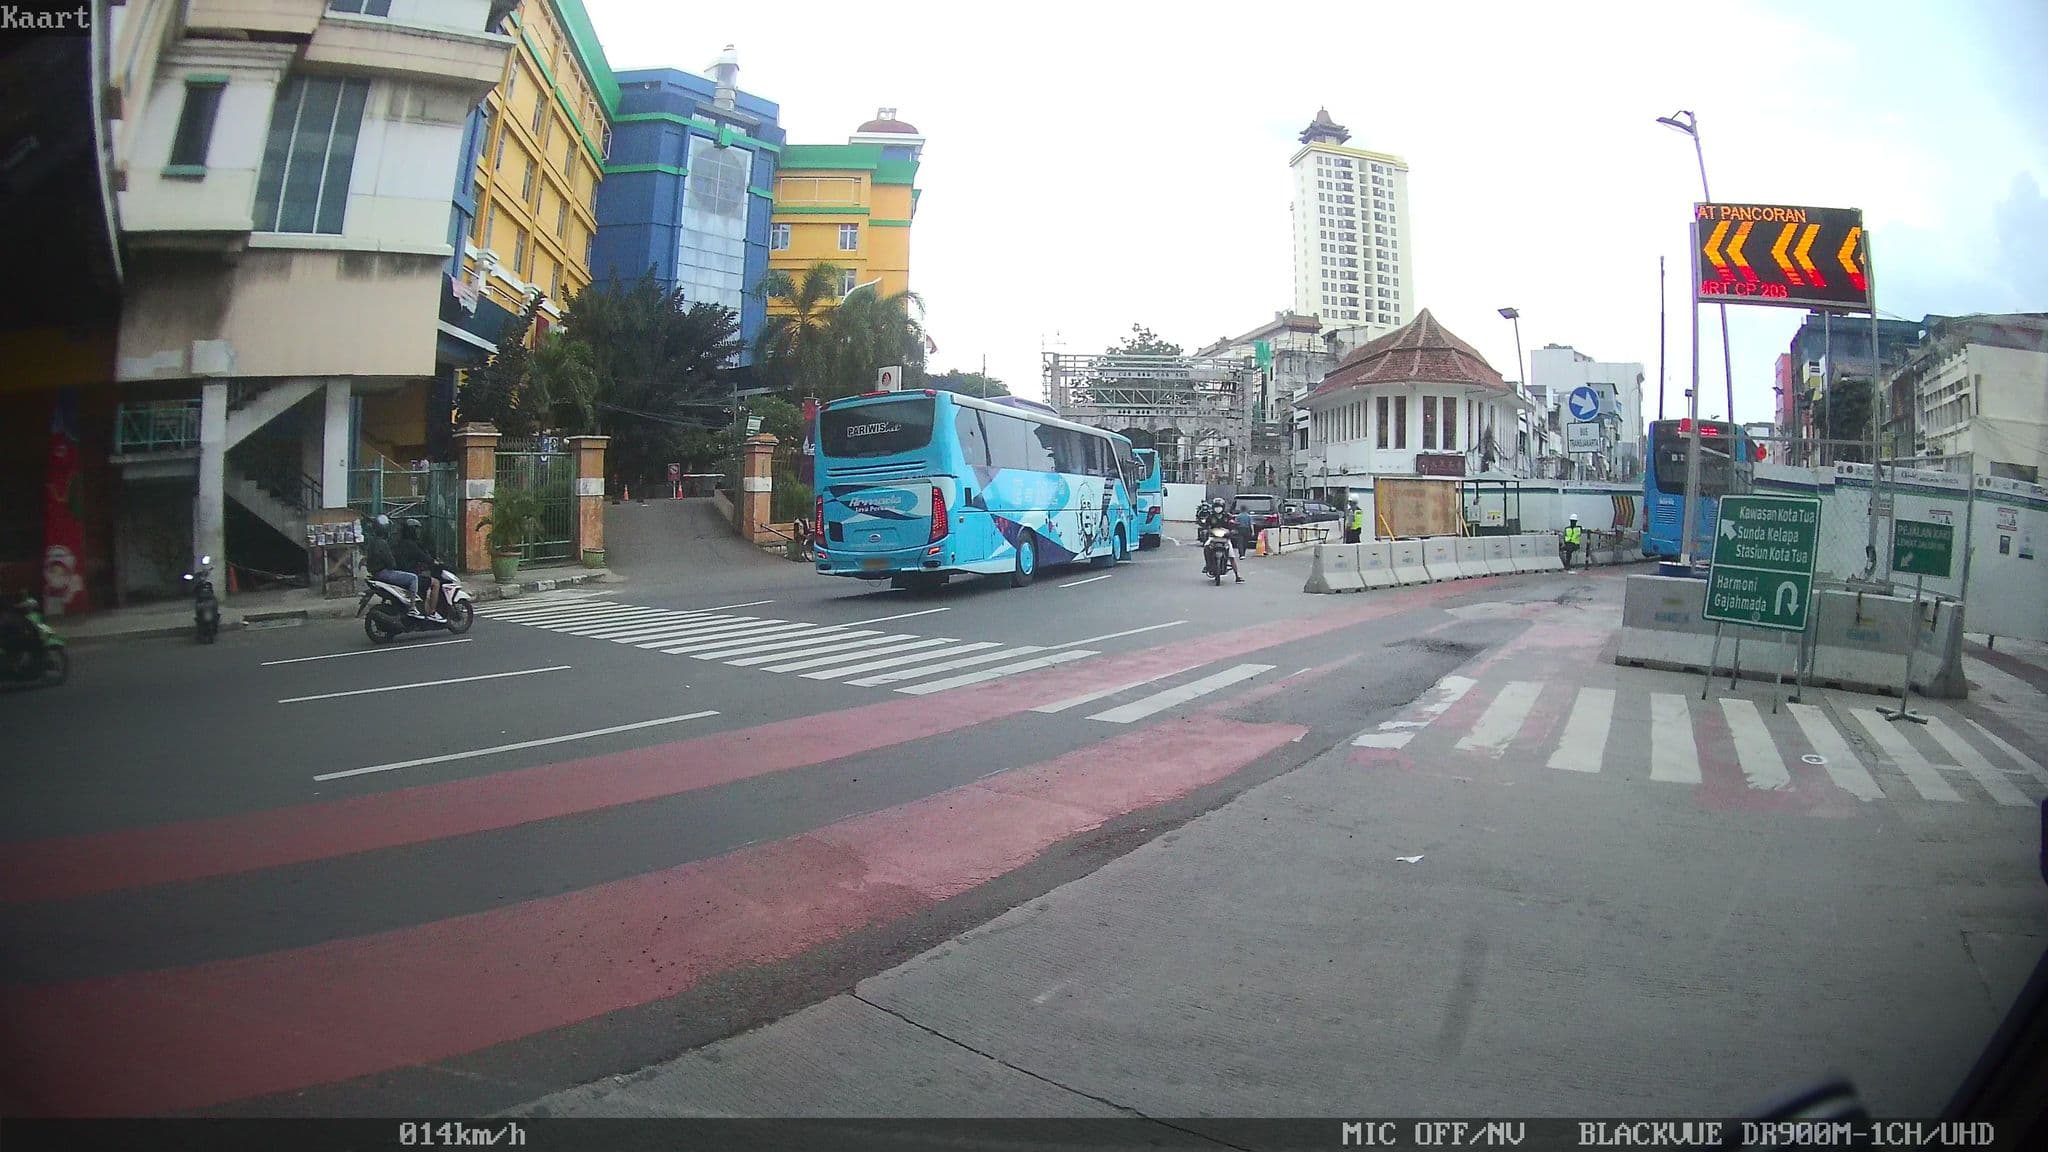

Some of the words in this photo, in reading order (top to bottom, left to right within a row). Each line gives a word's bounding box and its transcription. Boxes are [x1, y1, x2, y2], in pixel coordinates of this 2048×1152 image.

[1721, 206, 1807, 223] PANCORAN
[1735, 283, 1757, 296] CP
[1761, 284, 1788, 298] 203
[847, 422, 902, 437] PARIWIS
[1740, 506, 1777, 521] Kawasan
[1778, 508, 1798, 522] Kota
[1800, 509, 1815, 523] Tua
[1737, 526, 1765, 540] Sunda
[1767, 527, 1799, 545] Kelapa
[1736, 544, 1767, 560] Stasiun
[1769, 546, 1790, 562] Kota
[1792, 549, 1808, 563] Tua
[1716, 575, 1758, 591] Harmoni
[1714, 593, 1767, 611] Gajahmada
